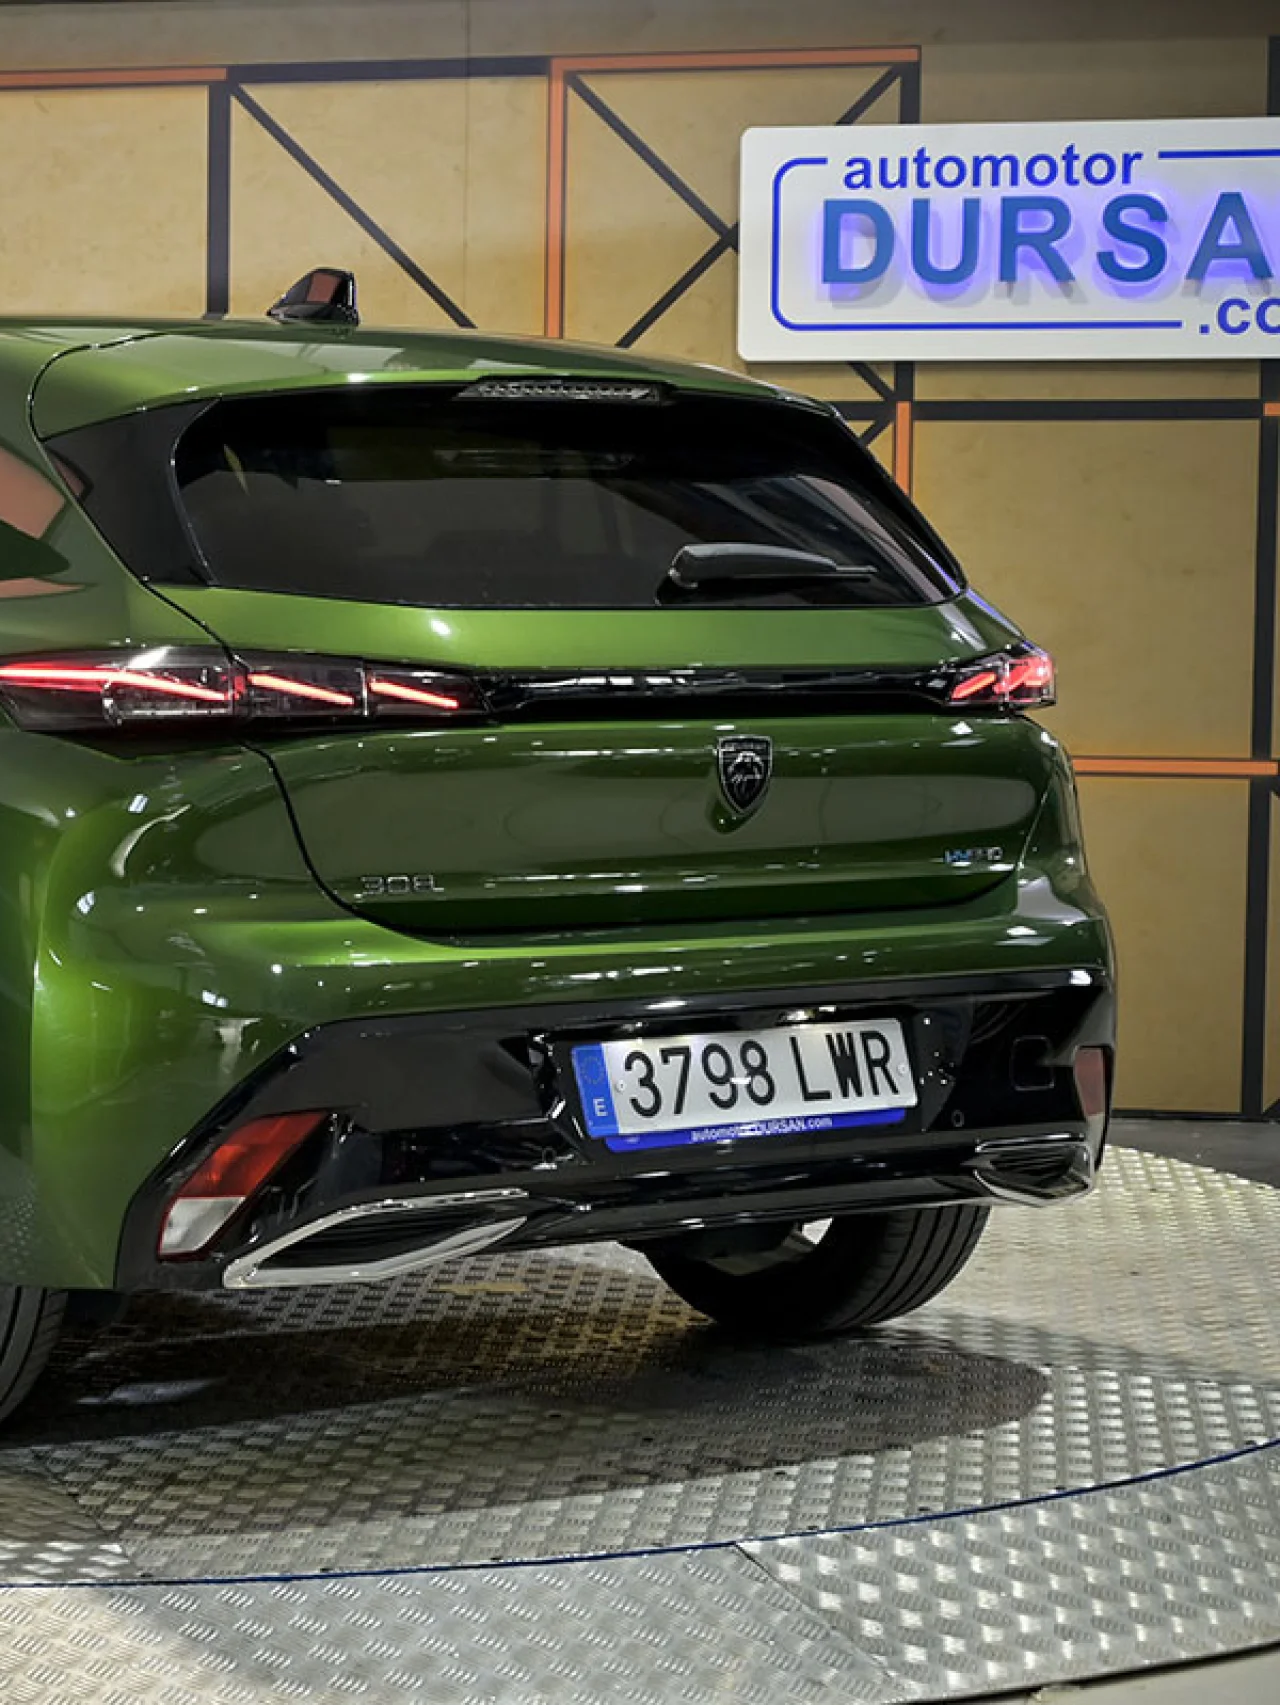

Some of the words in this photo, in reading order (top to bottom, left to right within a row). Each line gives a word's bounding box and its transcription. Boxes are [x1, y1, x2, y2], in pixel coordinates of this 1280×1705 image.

[843, 144, 1144, 190] automotor
[822, 191, 1274, 285] DURSA
[624, 1040, 776, 1117] 3798
[790, 1030, 899, 1102] LWR
[593, 1098, 609, 1117] E
